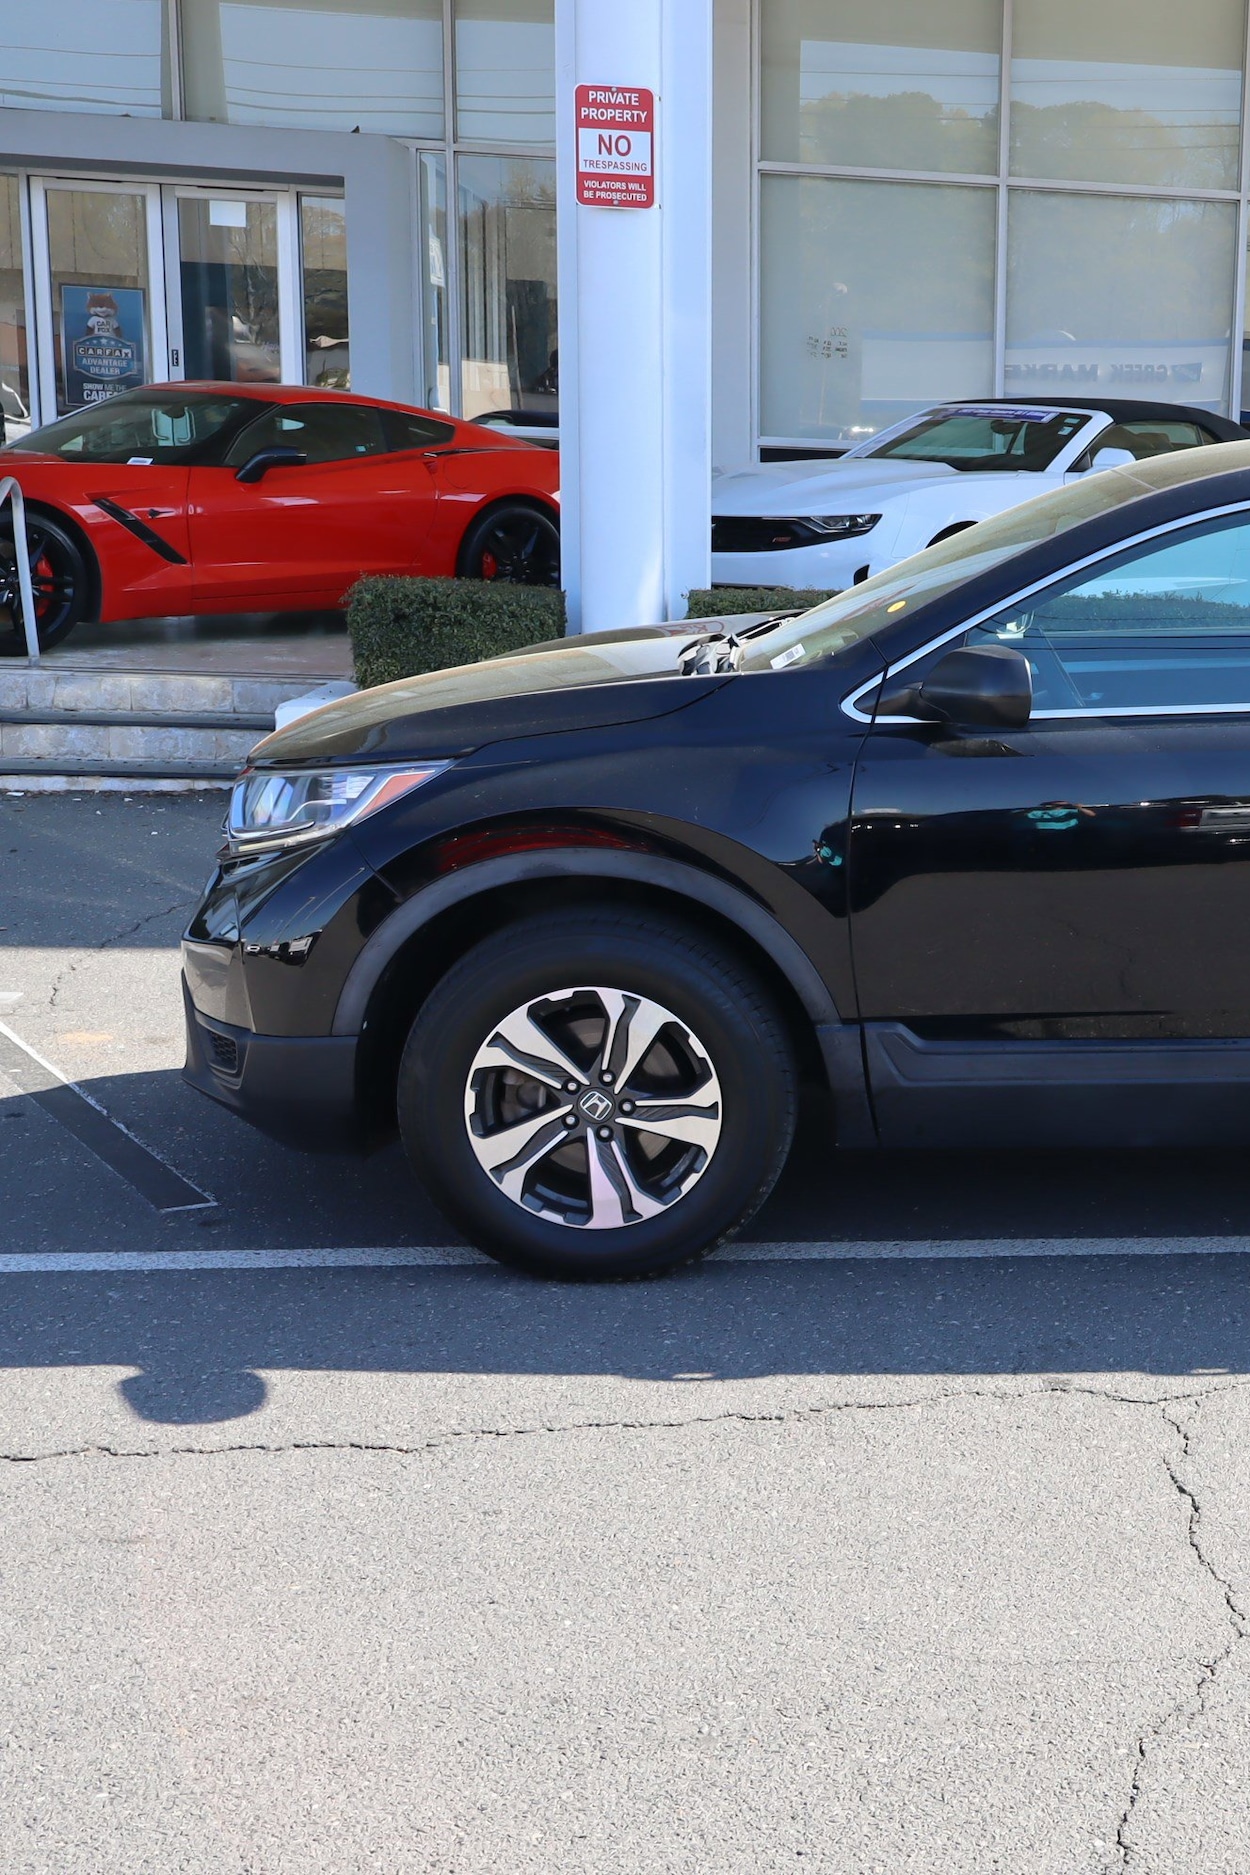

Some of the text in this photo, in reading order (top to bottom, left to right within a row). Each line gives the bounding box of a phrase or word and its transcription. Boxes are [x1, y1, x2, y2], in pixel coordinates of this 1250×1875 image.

[588, 90, 639, 105] PRIVATE
[581, 107, 647, 123] PROPERTY
[598, 134, 632, 157] NO
[583, 159, 647, 172] TRESPASSING
[583, 180, 647, 191] VIOLATORS WILL
[583, 190, 647, 201] BE PROSECUTED
[78, 347, 131, 359] CARFAX
[82, 358, 128, 367] ADVANTAGE
[90, 367, 120, 375] DEALER
[83, 382, 104, 390] SHOW
